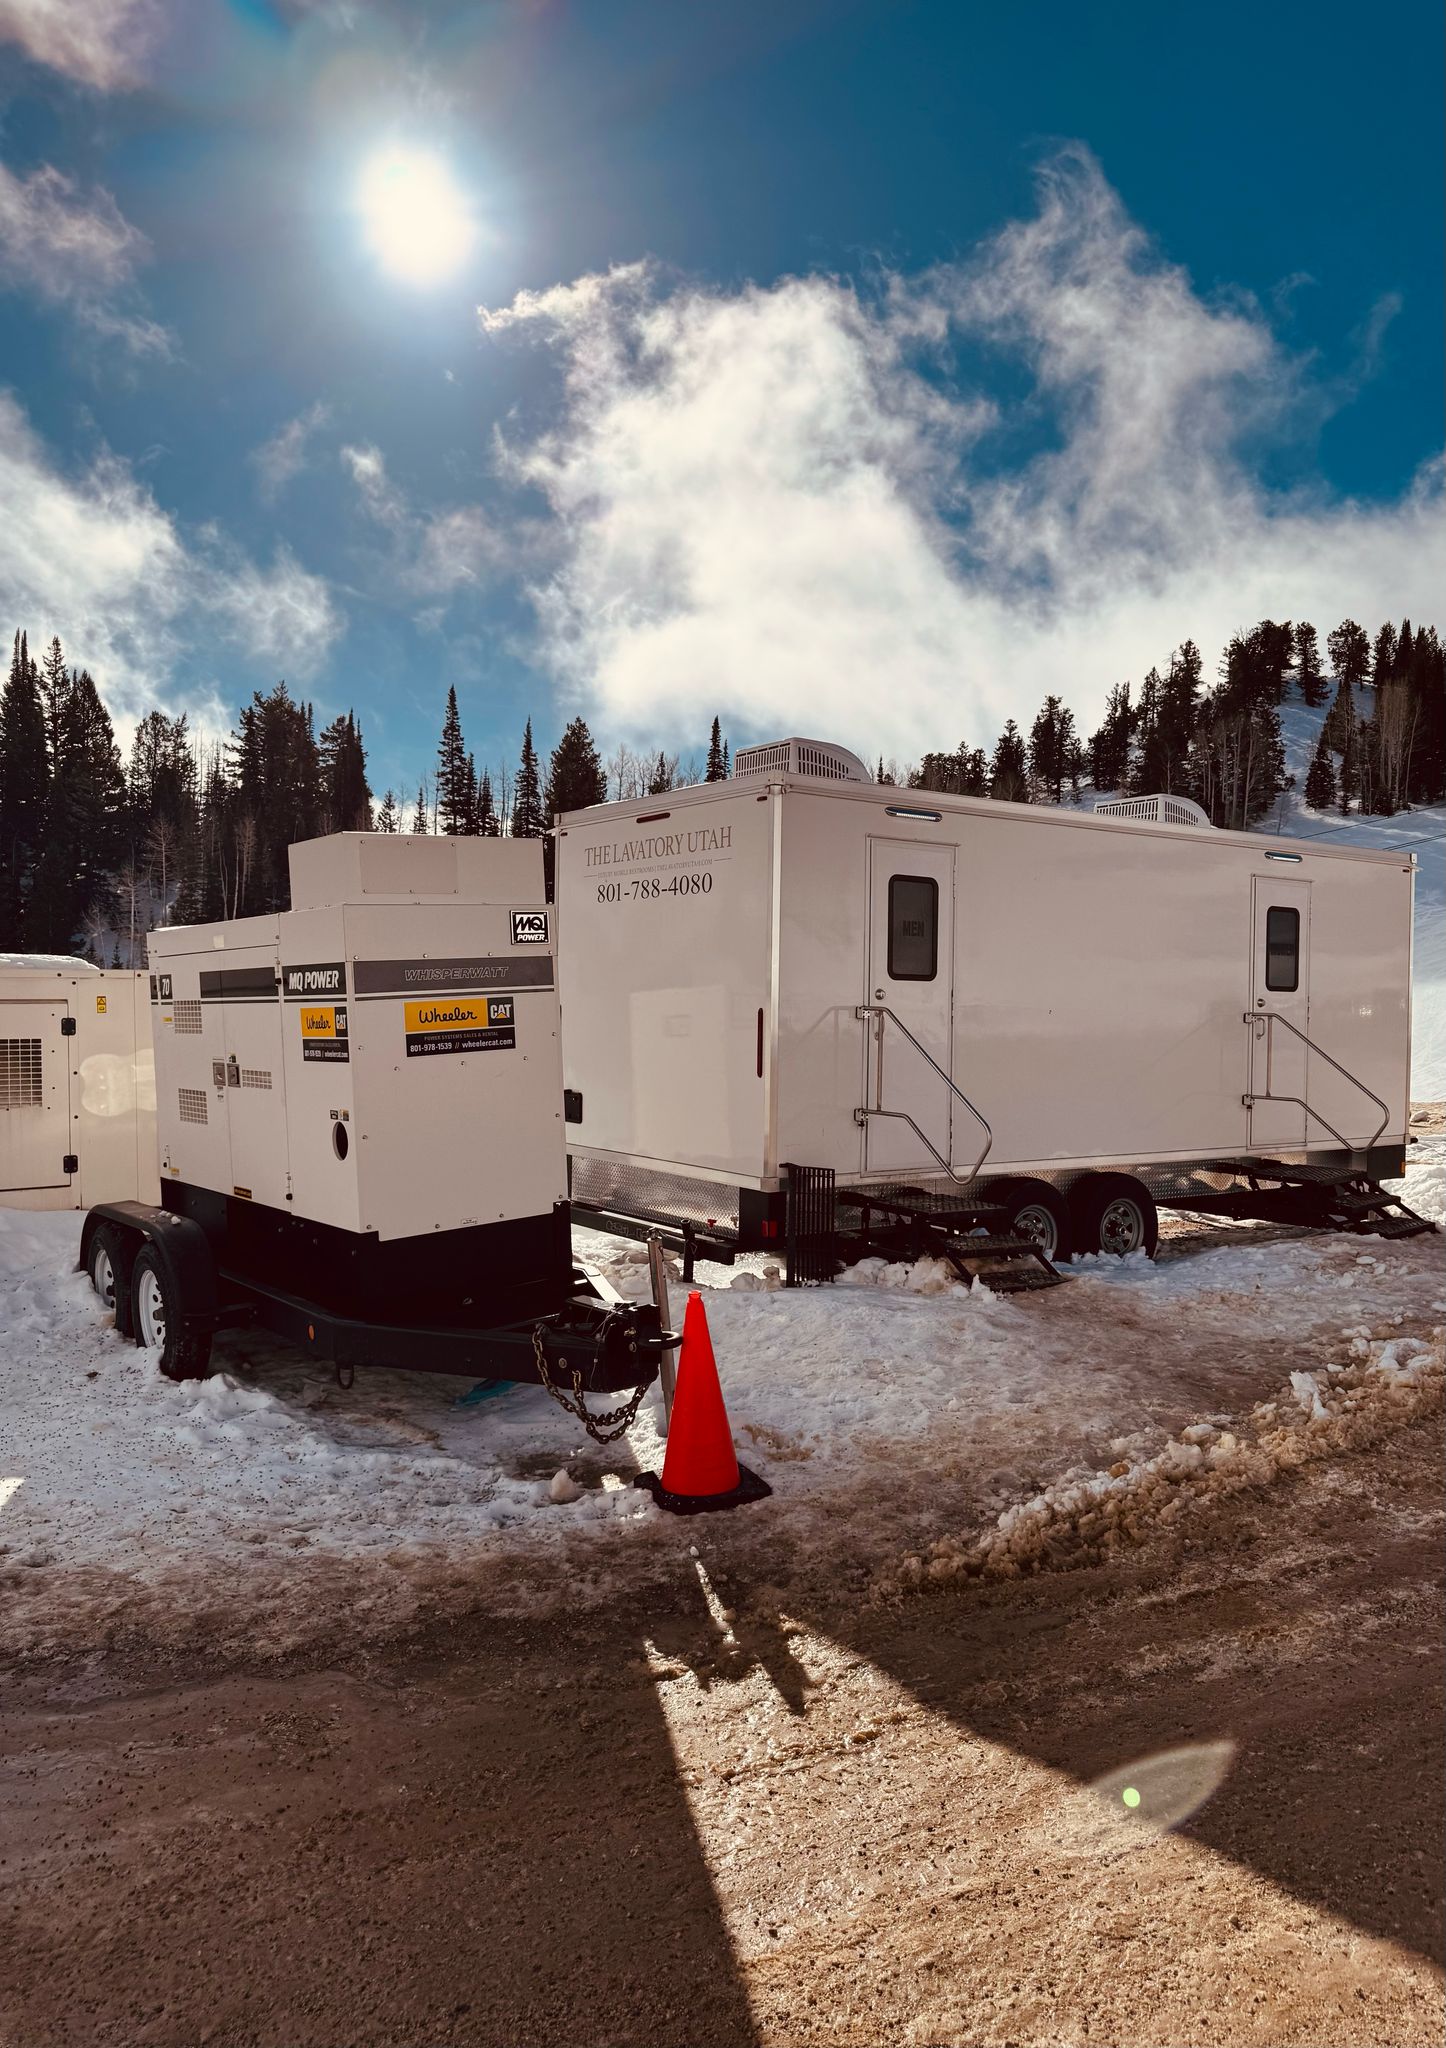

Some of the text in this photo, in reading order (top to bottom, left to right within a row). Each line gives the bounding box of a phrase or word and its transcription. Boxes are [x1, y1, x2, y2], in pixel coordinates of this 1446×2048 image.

[584, 825, 732, 866] THE LAVATORY UTAH
[597, 872, 713, 903] 801-788-4080
[515, 915, 546, 932] MQ
[902, 919, 925, 937] MEN
[517, 934, 546, 942] POWER
[288, 970, 340, 992] MQ POWER
[404, 966, 509, 981] WHISPERWATT
[162, 978, 170, 996] 70
[306, 1014, 347, 1030] Wheeler CAT
[418, 1004, 511, 1024] Wheeler CAT
[441, 1032, 463, 1040] SYSTEMS
[410, 1042, 453, 1053] 801-978-1539
[461, 1038, 513, 1049] wheelercat.com
